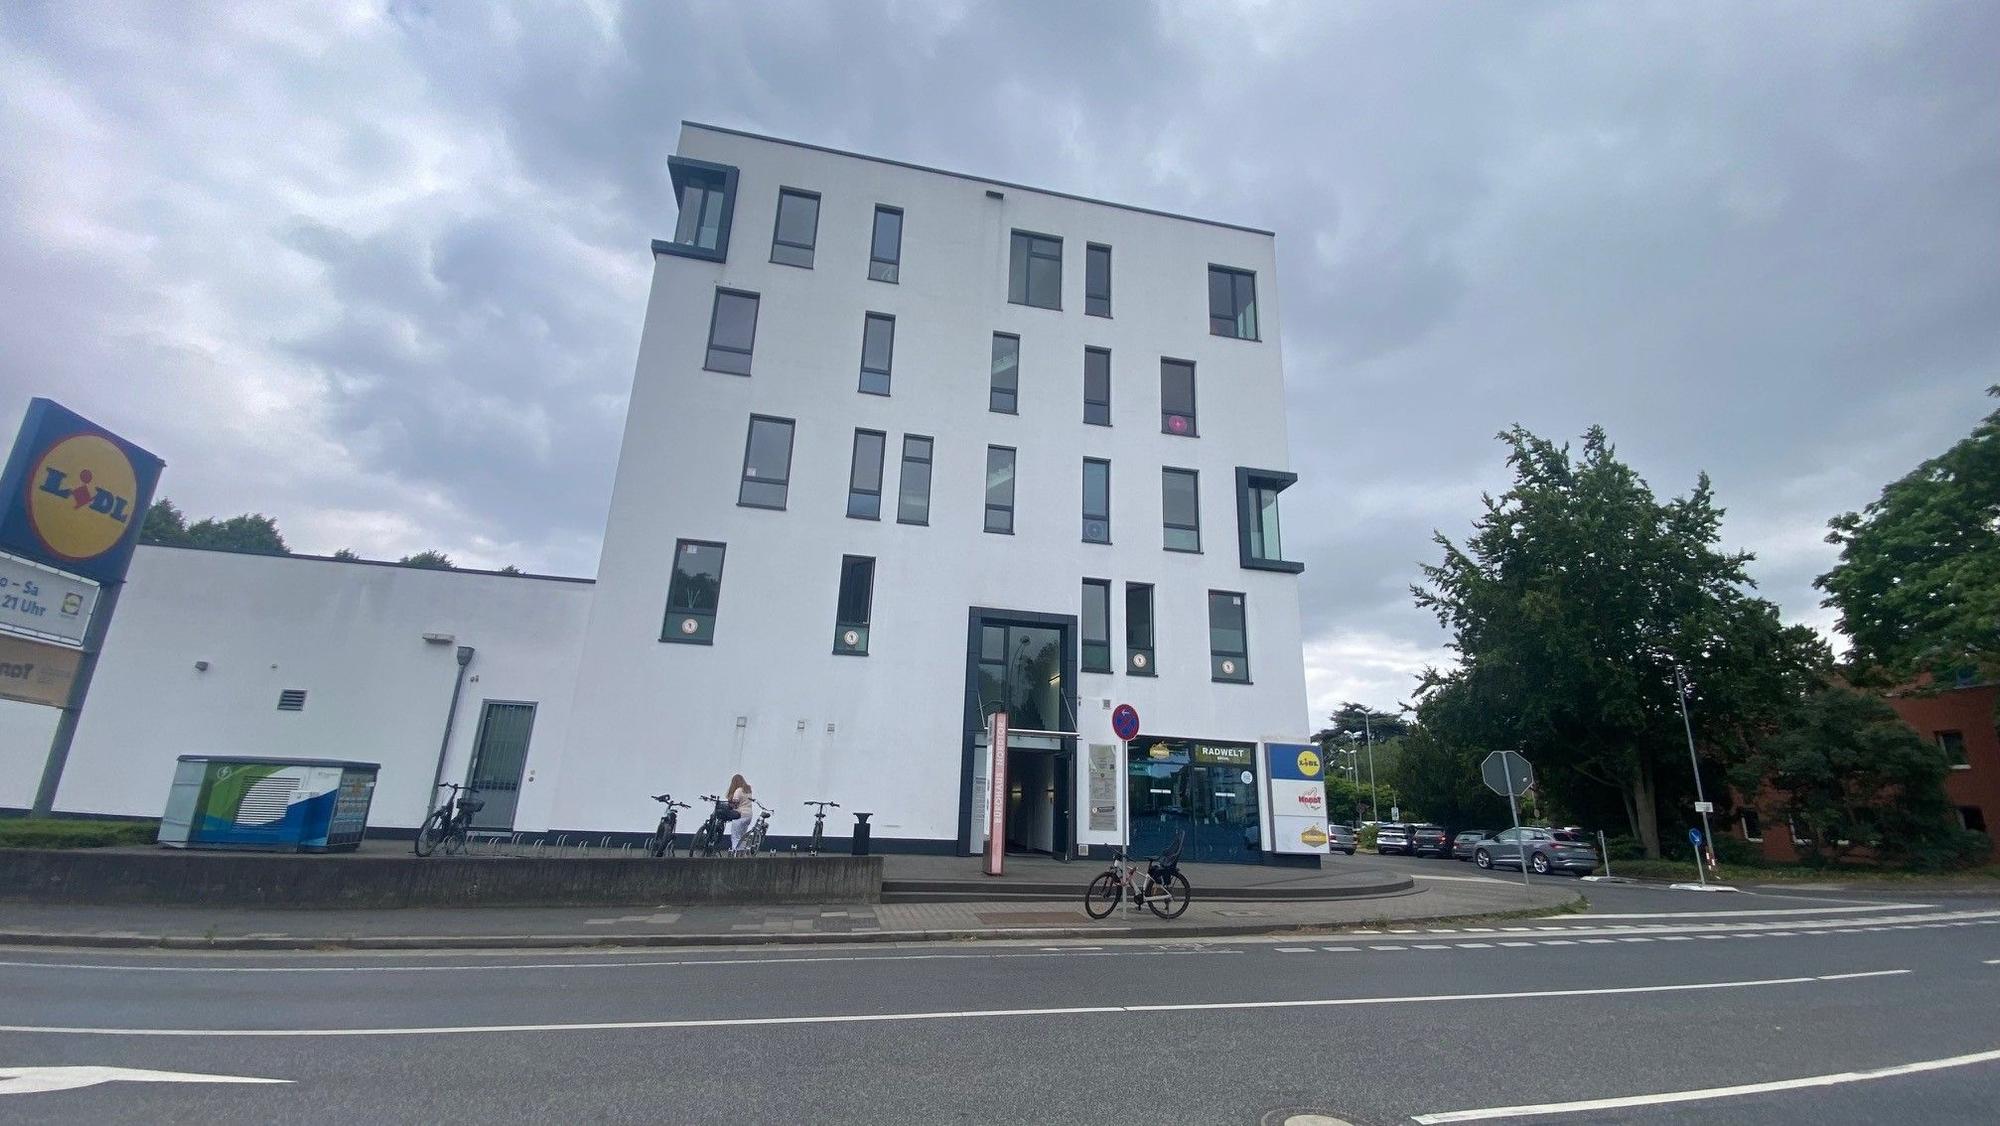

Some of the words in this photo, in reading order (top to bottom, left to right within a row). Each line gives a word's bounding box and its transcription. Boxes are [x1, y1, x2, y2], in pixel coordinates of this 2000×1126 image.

[23, 580, 39, 597] Sa
[2, 595, 18, 610] 21
[21, 598, 47, 617] Uhr
[1202, 747, 1244, 757] RADWELT
